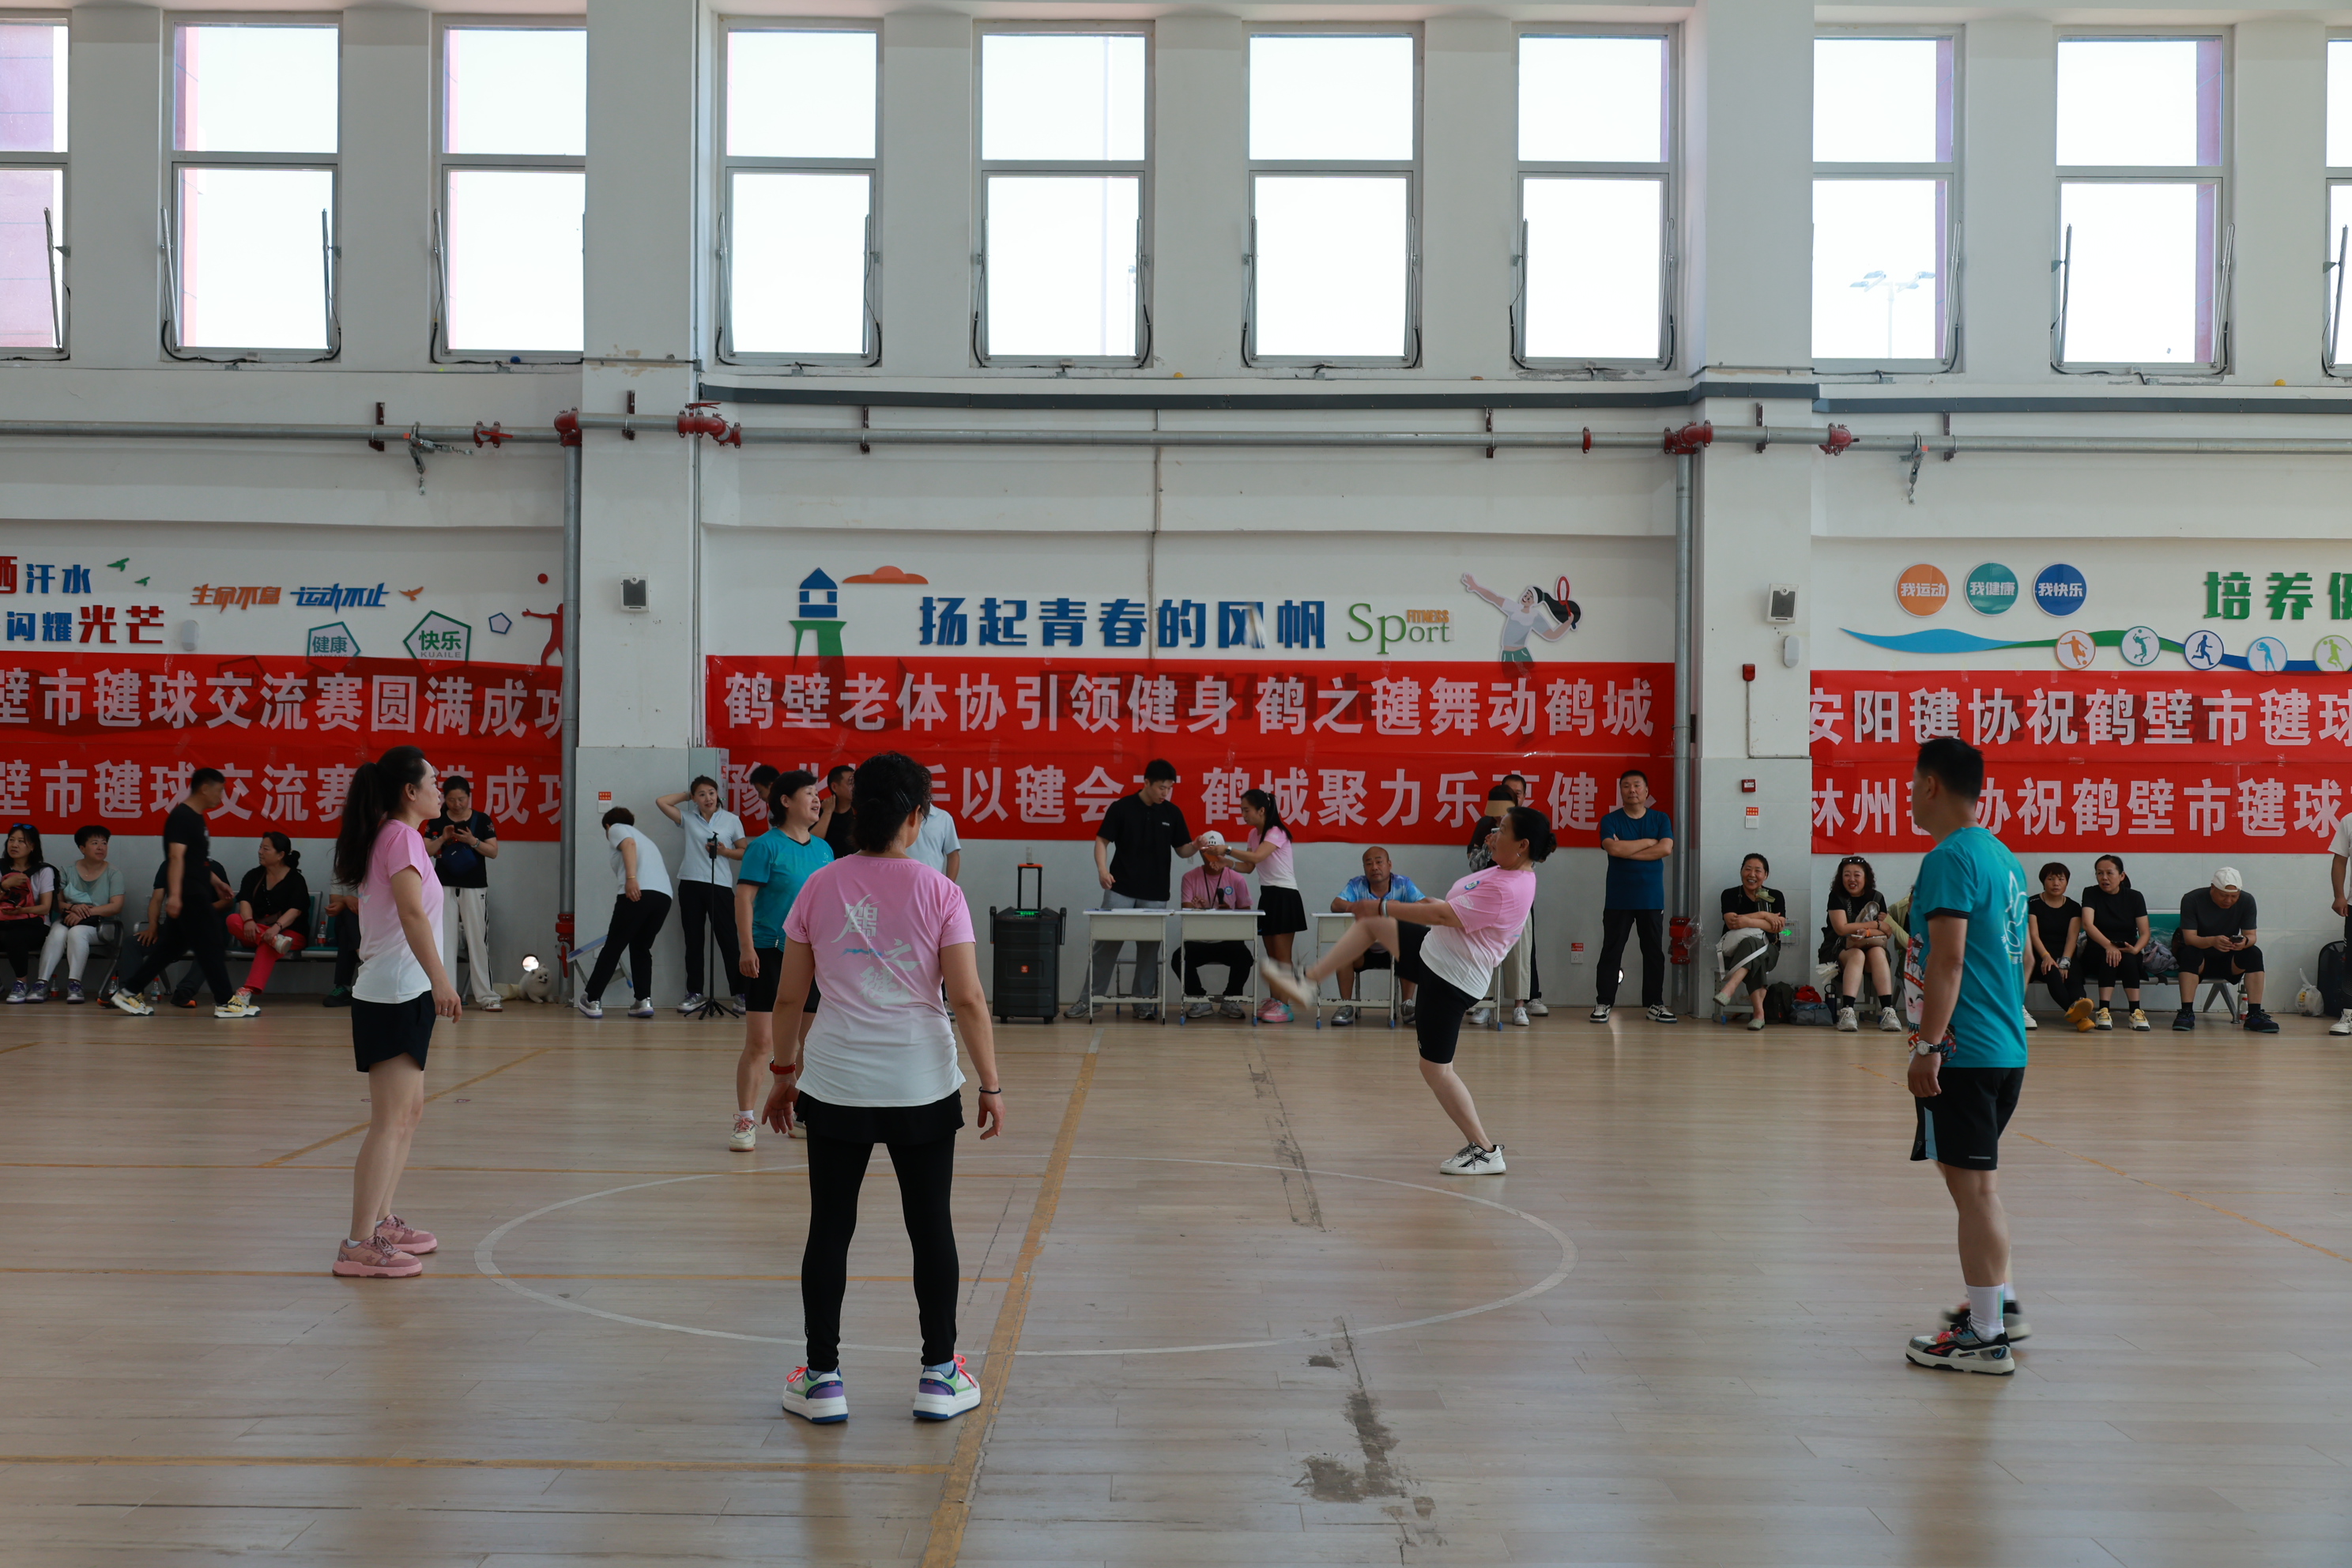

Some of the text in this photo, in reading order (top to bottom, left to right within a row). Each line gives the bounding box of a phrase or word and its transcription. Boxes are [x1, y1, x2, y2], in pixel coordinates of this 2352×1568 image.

[190, 582, 390, 614] 生命不息 运动不止
[1900, 582, 1947, 597] 我运动
[1969, 581, 2015, 597] 我健康
[2037, 582, 2083, 597] 我快乐
[6, 605, 164, 644] 闪耀光芒
[919, 597, 1326, 650] 扬起青春的风帆
[1347, 602, 1452, 654] Sport
[1407, 609, 1449, 624] FITNESS
[311, 635, 348, 654] 健康
[418, 630, 462, 651] 快乐
[0, 759, 561, 825] 壁市毽球交流赛成
[1811, 778, 2343, 839] 林州协祝鹤壁市毽球
